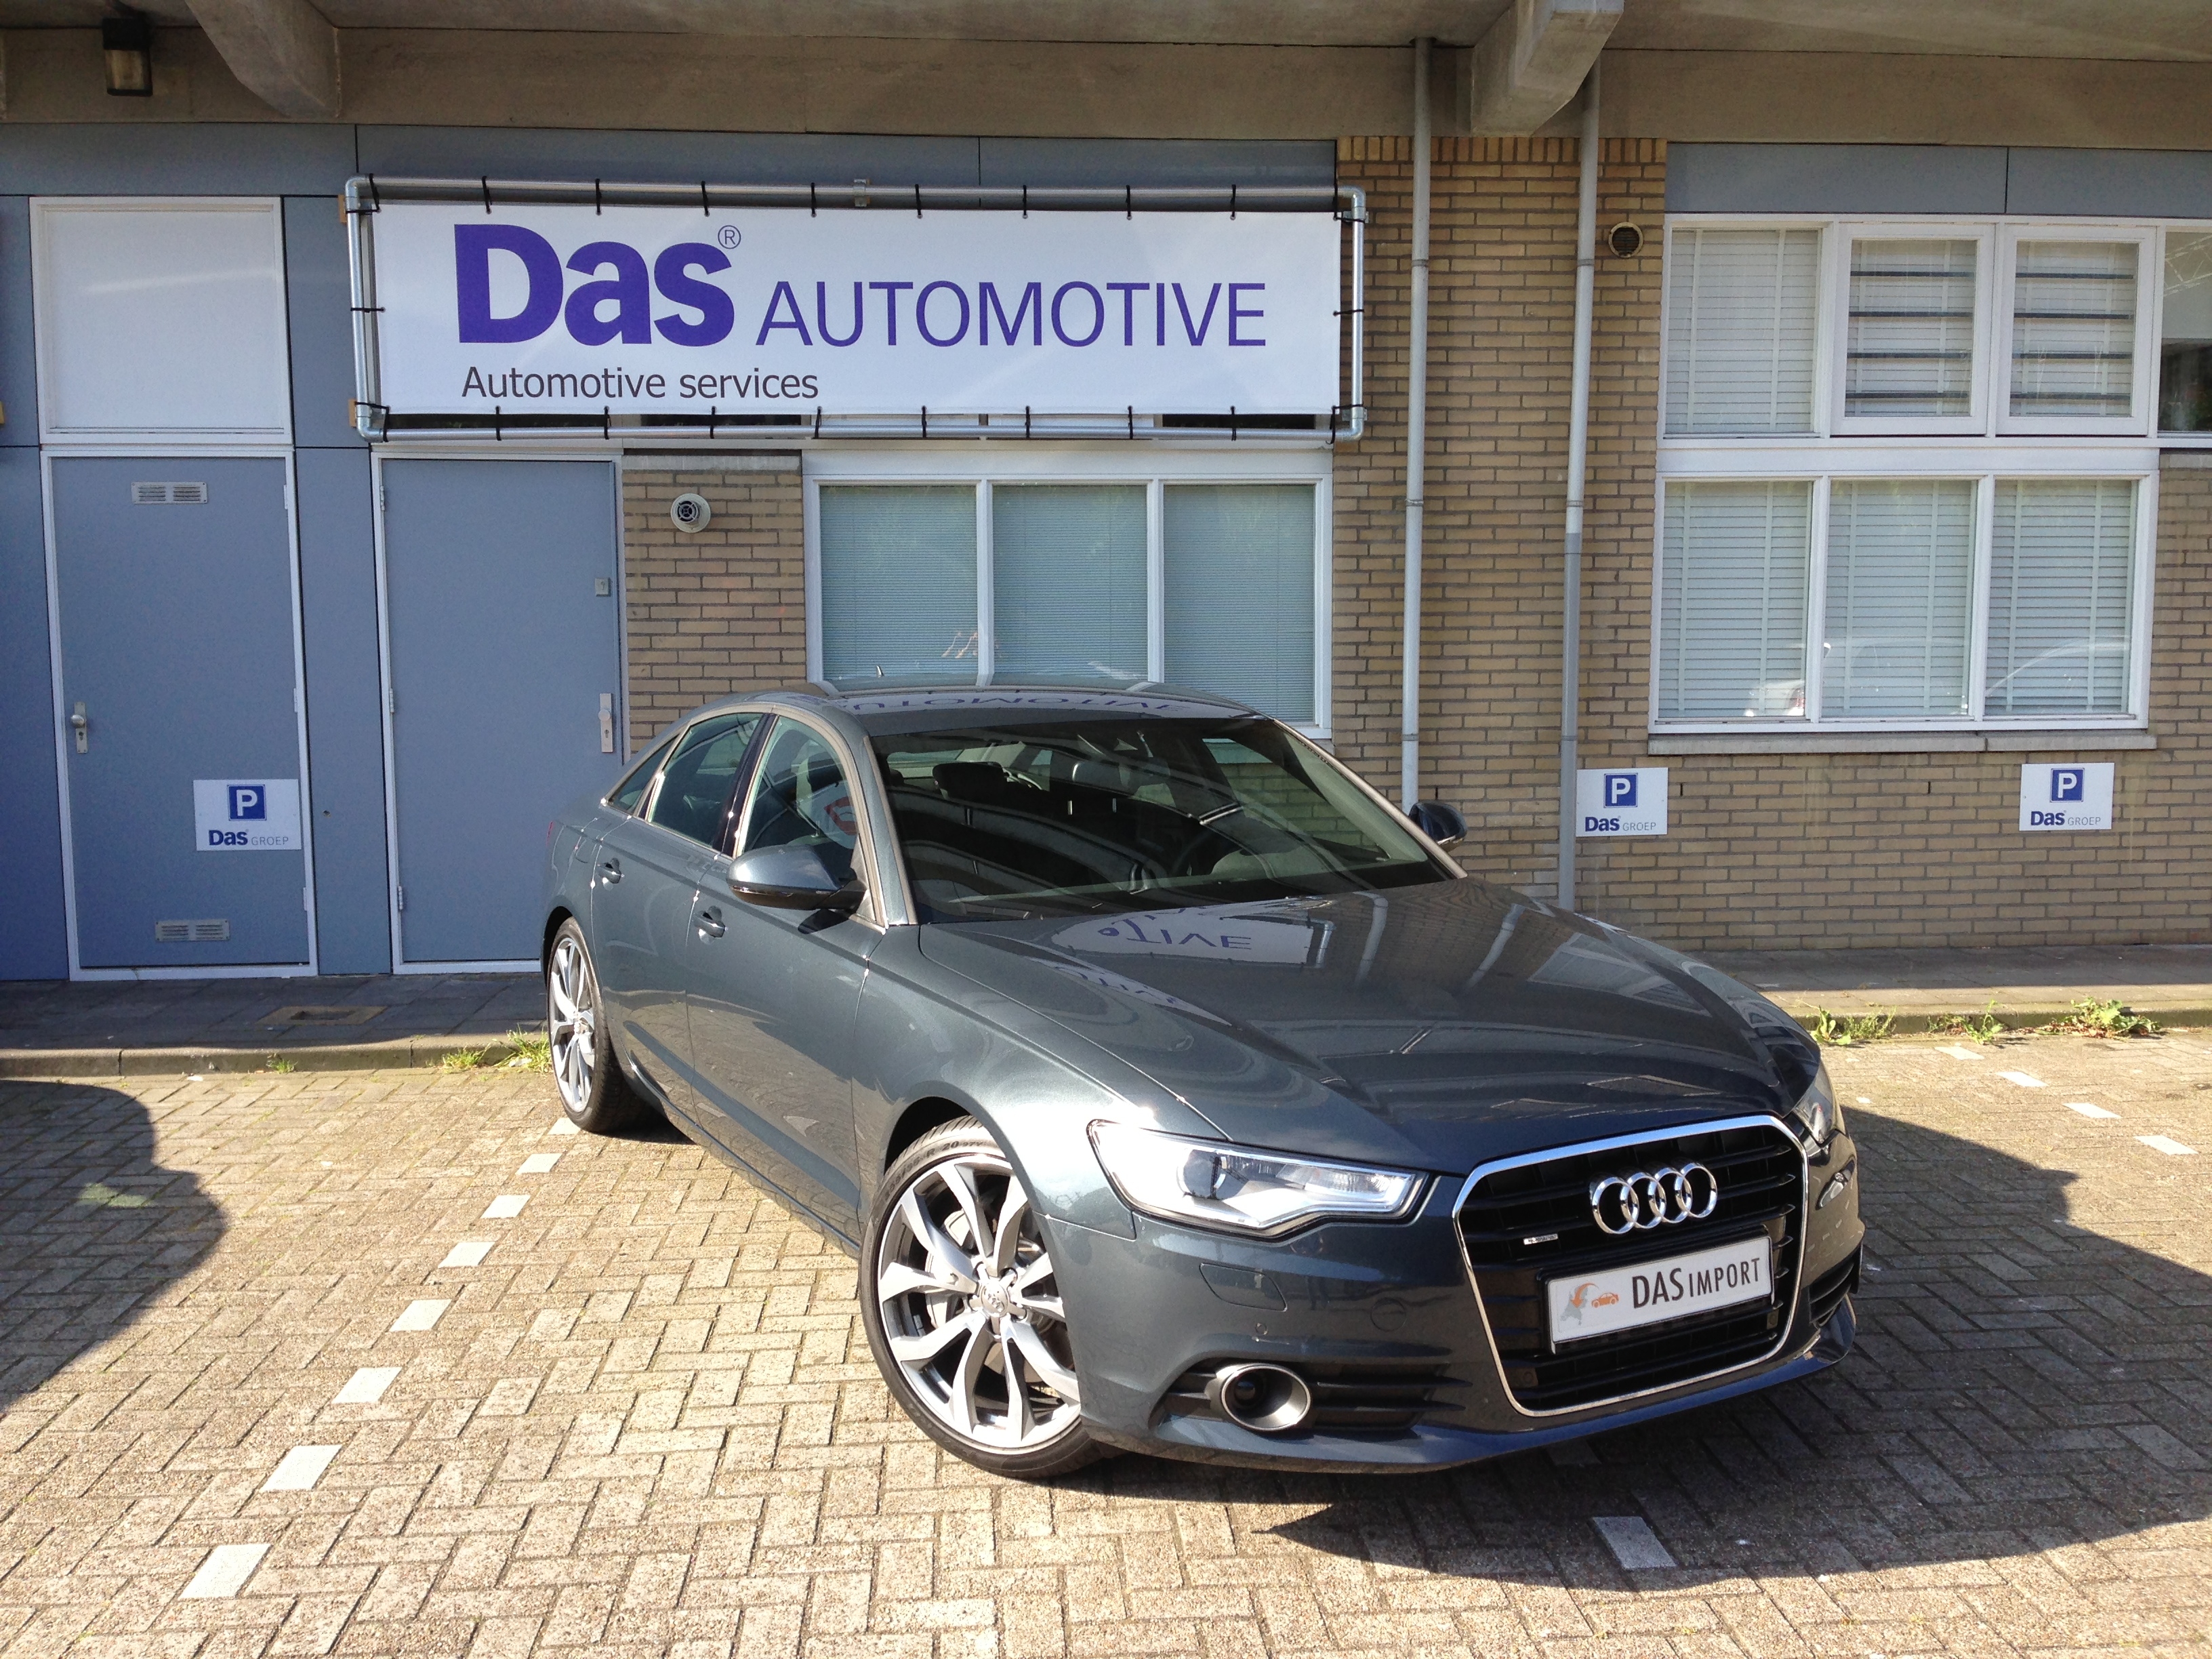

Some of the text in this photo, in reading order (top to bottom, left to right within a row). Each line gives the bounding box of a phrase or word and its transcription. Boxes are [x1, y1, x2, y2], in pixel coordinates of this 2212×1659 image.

[756, 281, 1266, 347] AUTOMOTIVE
[462, 367, 819, 398] Automotive services
[1612, 778, 1631, 804] P
[2057, 773, 2077, 798] P
[237, 790, 258, 817] P
[1585, 817, 1656, 832] Das GROEP
[2031, 811, 2101, 826] Das GROEP
[209, 830, 289, 846] Das GROEP
[941, 1141, 960, 1151] 20
[1632, 1257, 1761, 1309] DAS IMPORT
